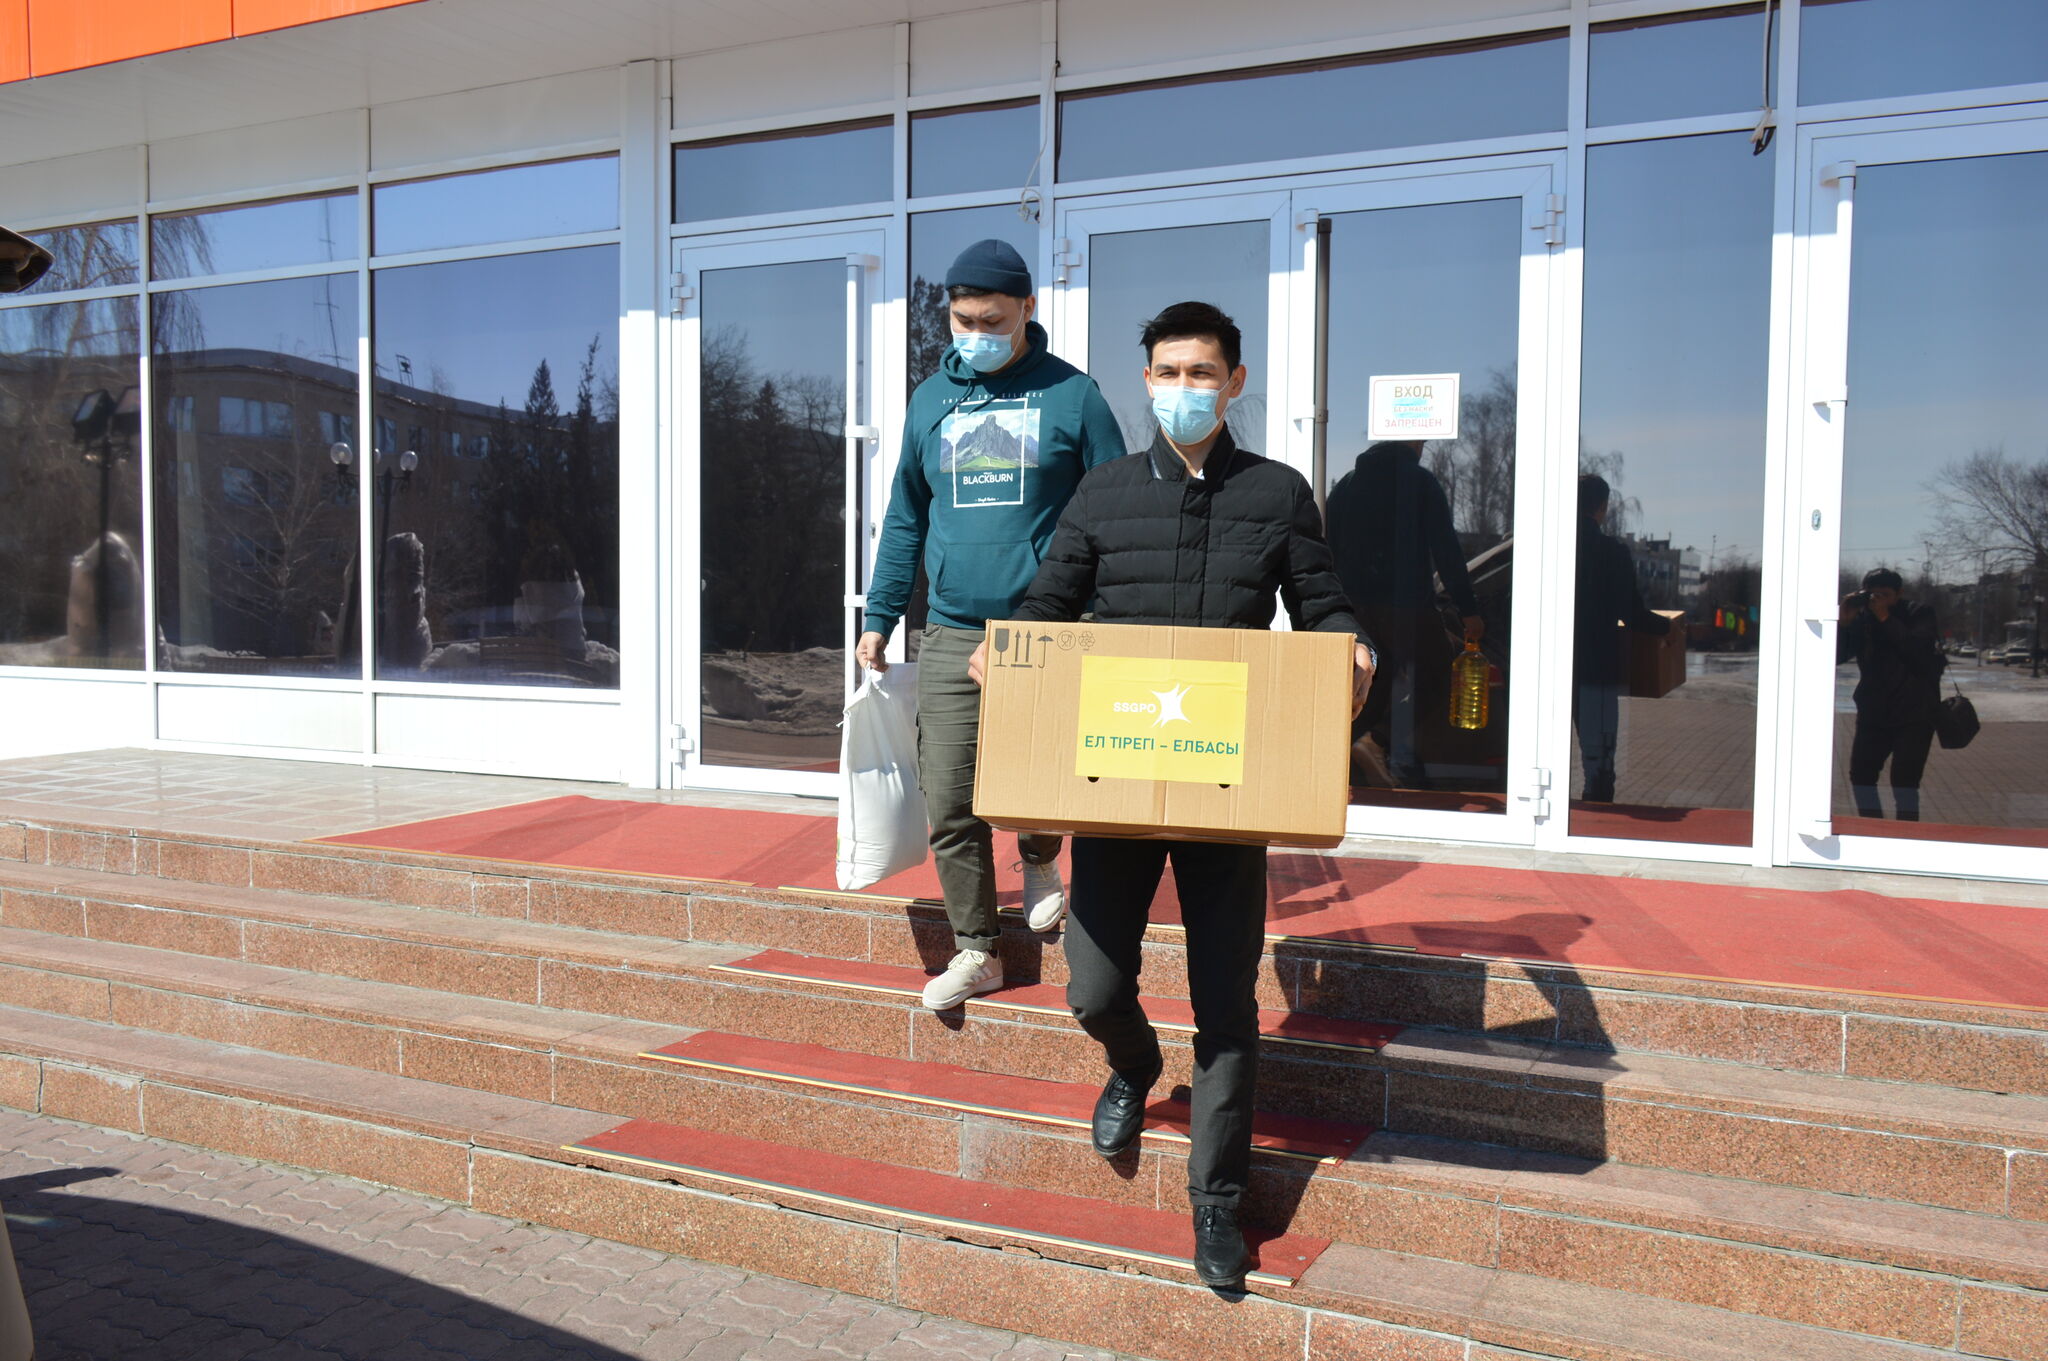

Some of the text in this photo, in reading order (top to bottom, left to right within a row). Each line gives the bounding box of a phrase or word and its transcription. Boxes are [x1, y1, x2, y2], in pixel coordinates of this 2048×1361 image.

[1394, 385, 1433, 399] ВХОД
[1384, 418, 1442, 428] ЗАПРЕЩЕН
[962, 473, 1014, 485] BLACKBURN
[1113, 702, 1157, 714] SSGPO
[1084, 735, 1105, 748] ЕЛ
[1109, 736, 1155, 750] ТІРЕГІ
[1173, 739, 1239, 755] ЕЛБАСЫ
